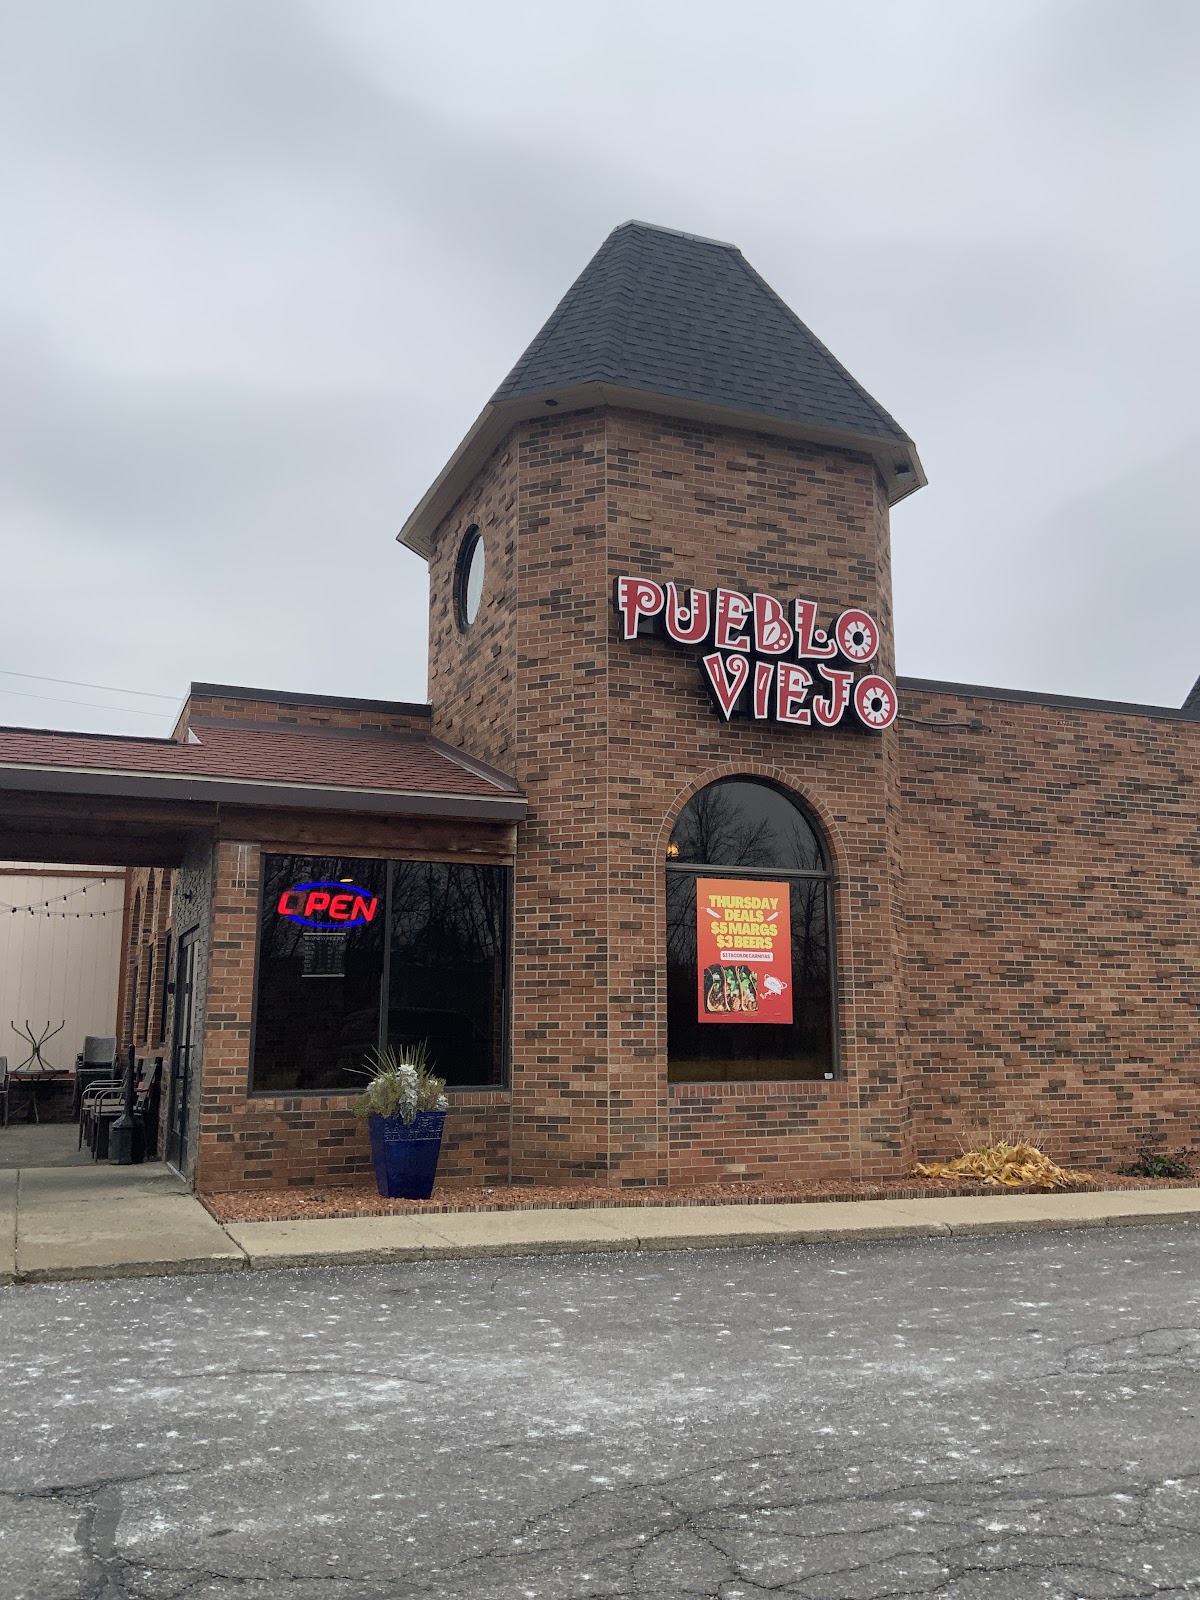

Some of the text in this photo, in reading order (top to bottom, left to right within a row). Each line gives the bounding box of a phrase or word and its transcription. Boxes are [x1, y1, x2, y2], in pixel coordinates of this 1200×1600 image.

[618, 576, 879, 663] PUEBLO
[702, 652, 898, 729] VIEJO
[277, 889, 378, 921] OPEN
[709, 895, 778, 910] THURSDAY
[725, 909, 764, 922] DEALS
[711, 921, 778, 936] $5 MARGS
[717, 934, 773, 949] $3 BEERS
